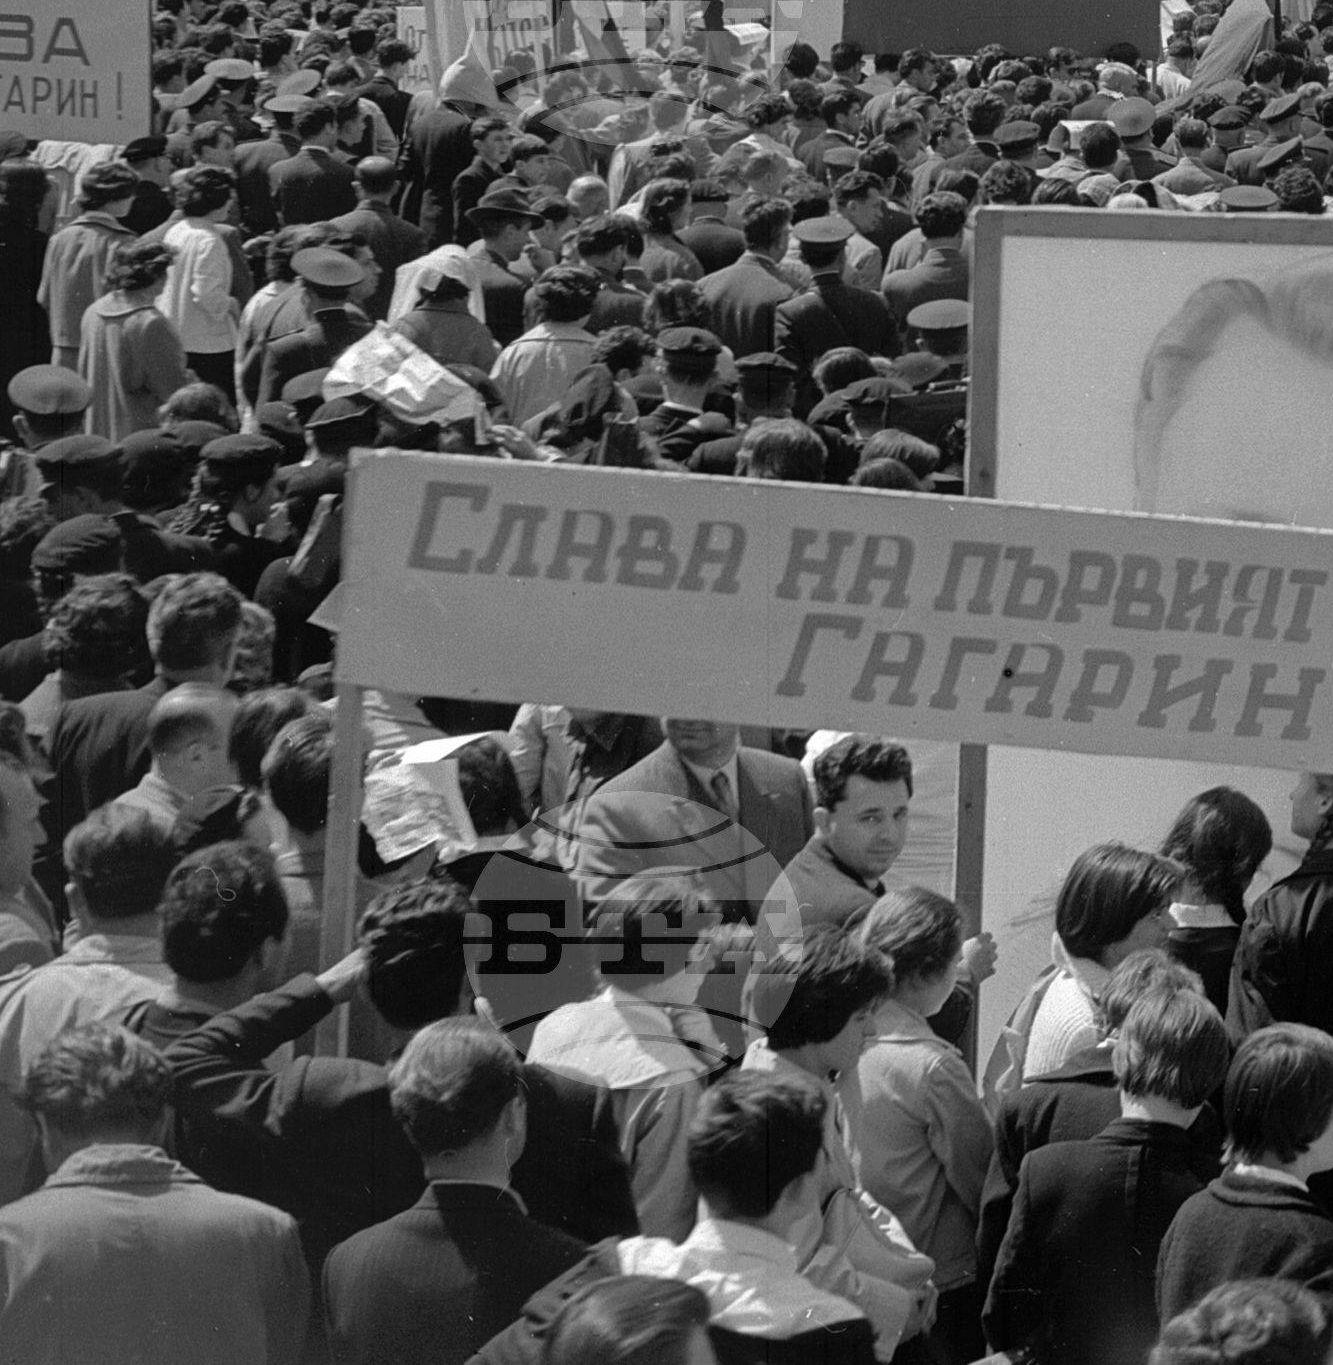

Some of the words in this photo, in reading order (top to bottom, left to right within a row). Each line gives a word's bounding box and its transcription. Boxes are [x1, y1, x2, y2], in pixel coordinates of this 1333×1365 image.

[0, 73, 98, 119] АРИН
[406, 480, 748, 595] СЛАВА
[775, 527, 917, 609] НА
[933, 539, 1329, 643] ПЪРВИЯТ
[776, 612, 1326, 742] ГАГАРИН
